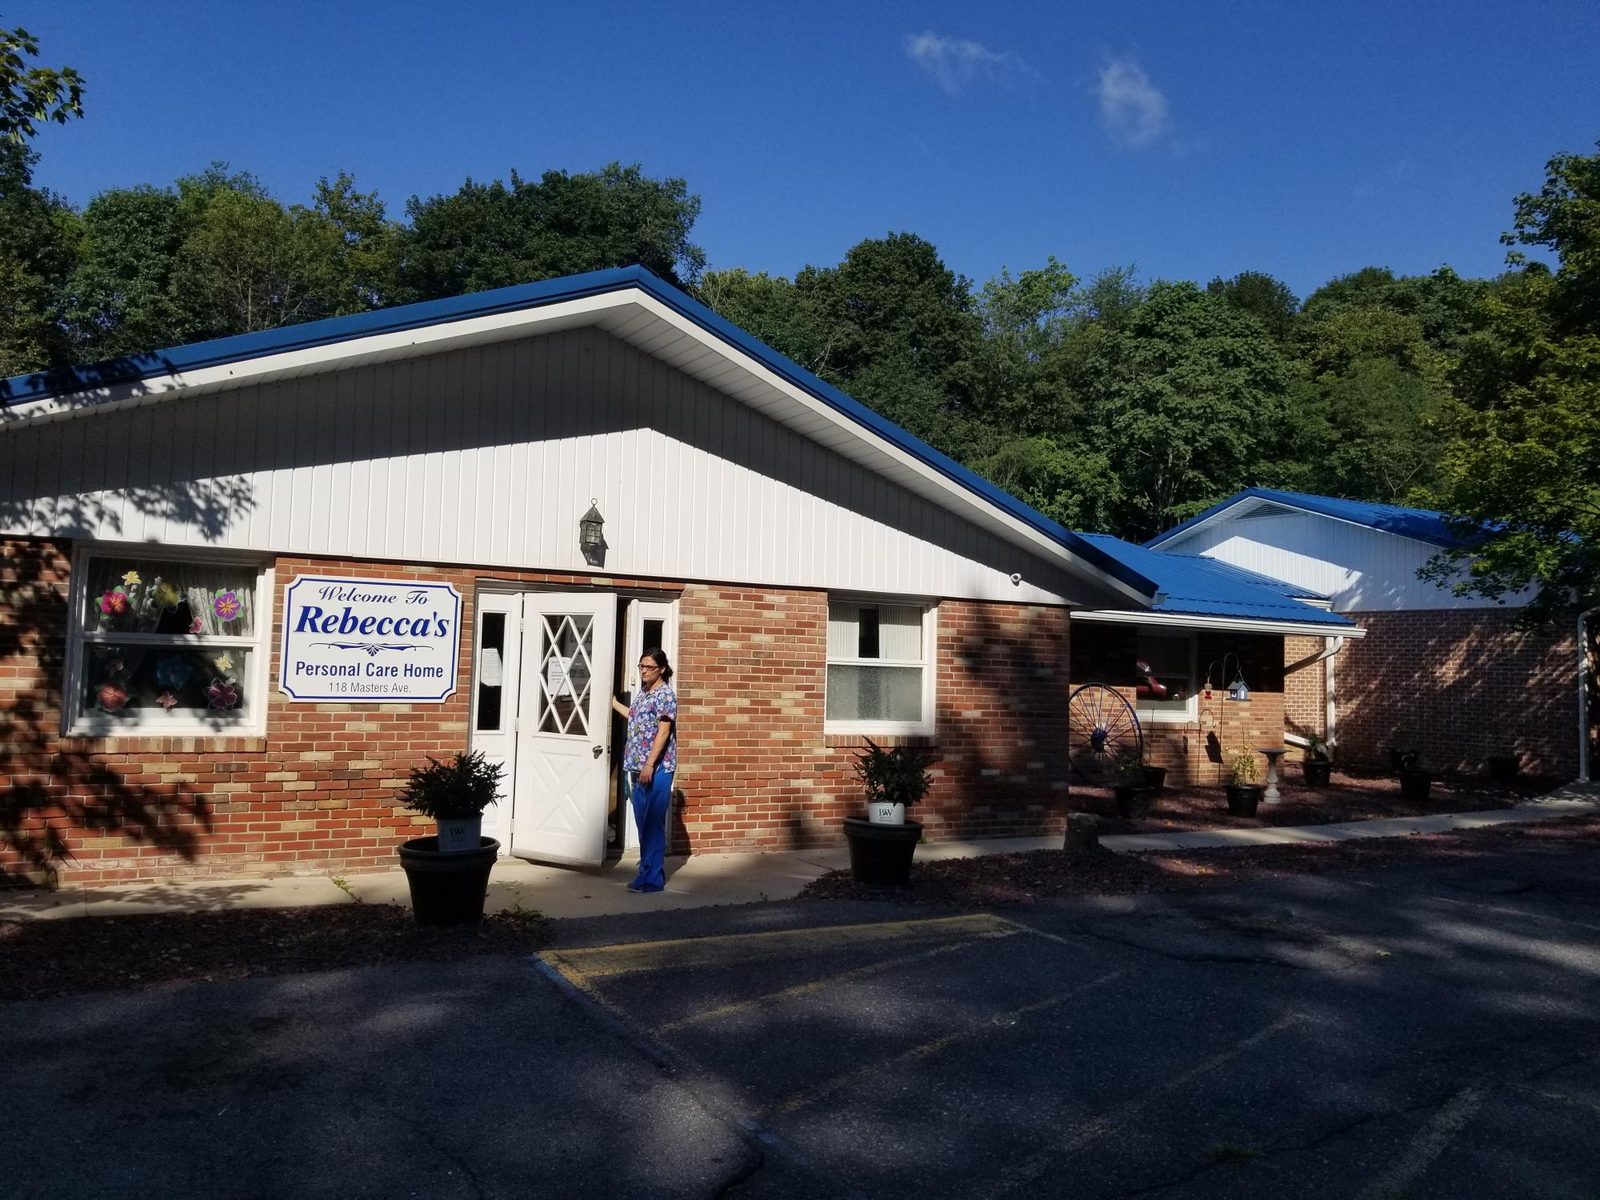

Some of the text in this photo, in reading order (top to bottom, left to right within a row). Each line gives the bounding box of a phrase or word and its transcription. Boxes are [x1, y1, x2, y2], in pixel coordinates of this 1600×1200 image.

[318, 585, 430, 605] Welcome To
[293, 605, 450, 638] Rebecca's
[296, 661, 444, 678] Personal Care Home
[328, 682, 412, 693] 118 Masters Ave.
